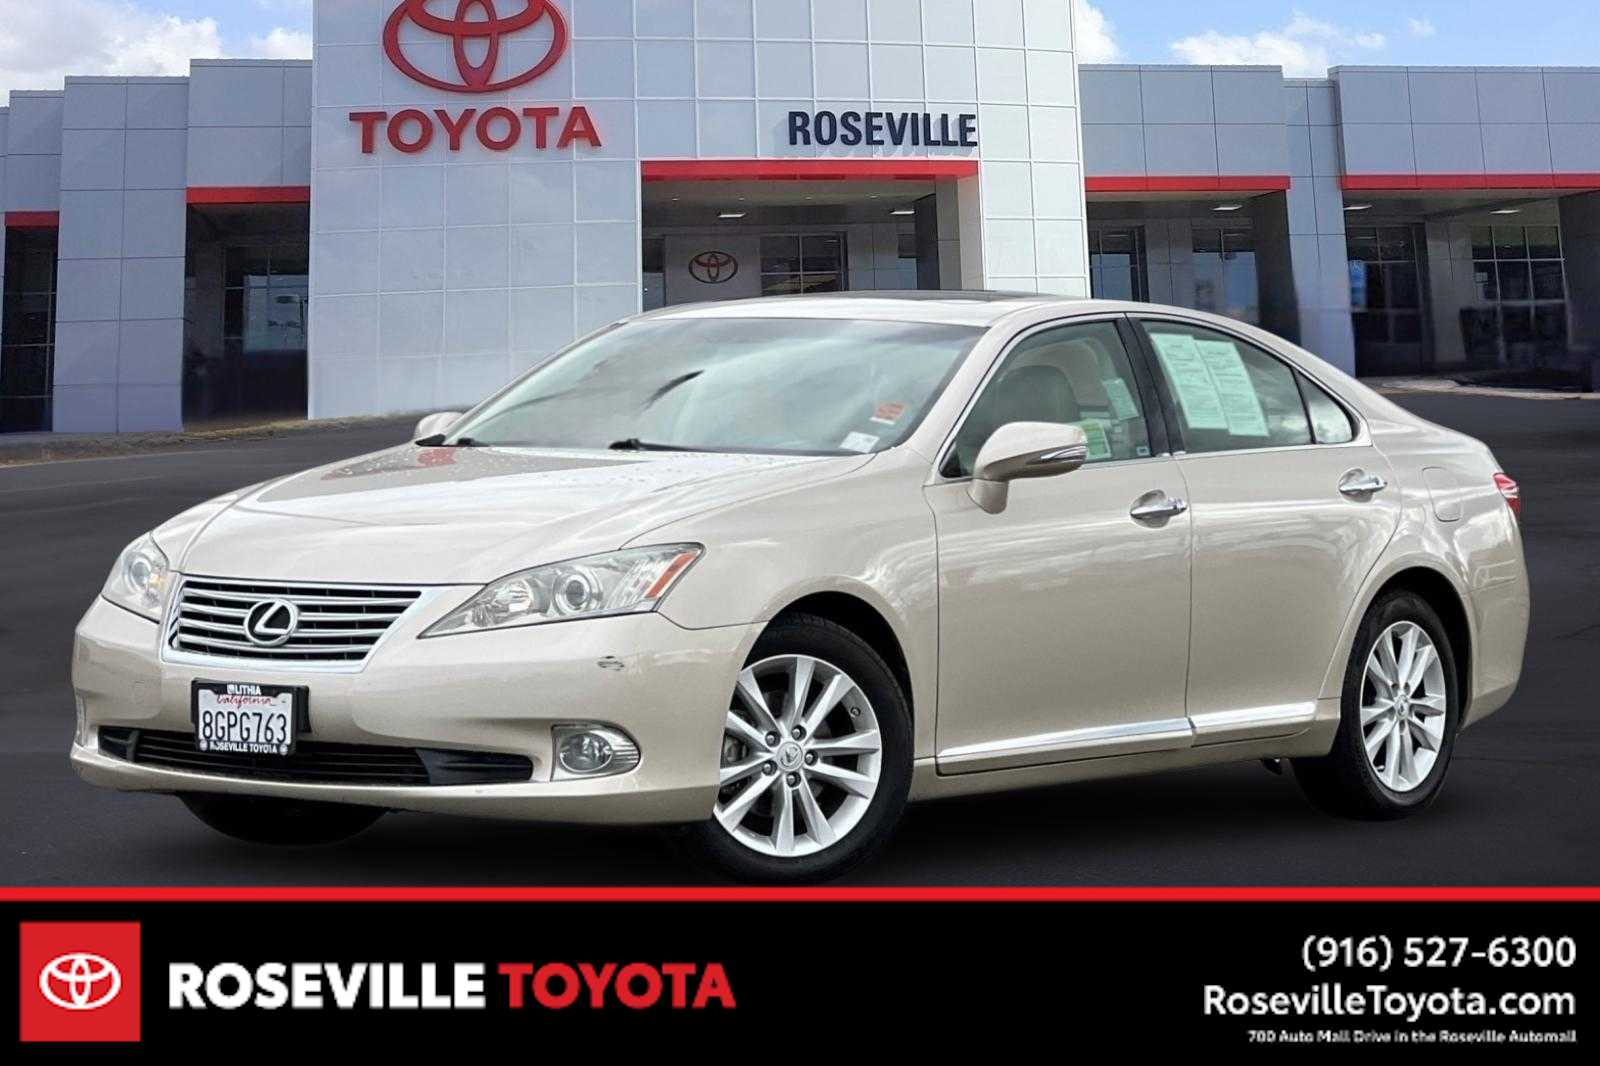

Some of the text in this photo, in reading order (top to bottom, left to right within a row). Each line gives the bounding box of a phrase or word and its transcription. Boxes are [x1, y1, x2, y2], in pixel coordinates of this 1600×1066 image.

[349, 106, 602, 154] TOYOTA
[788, 111, 978, 147] ROSEVILLE
[235, 684, 261, 695] LITHIA
[202, 710, 287, 743] 8GPG763
[209, 741, 277, 754] ROSEVILLE TOYOTA
